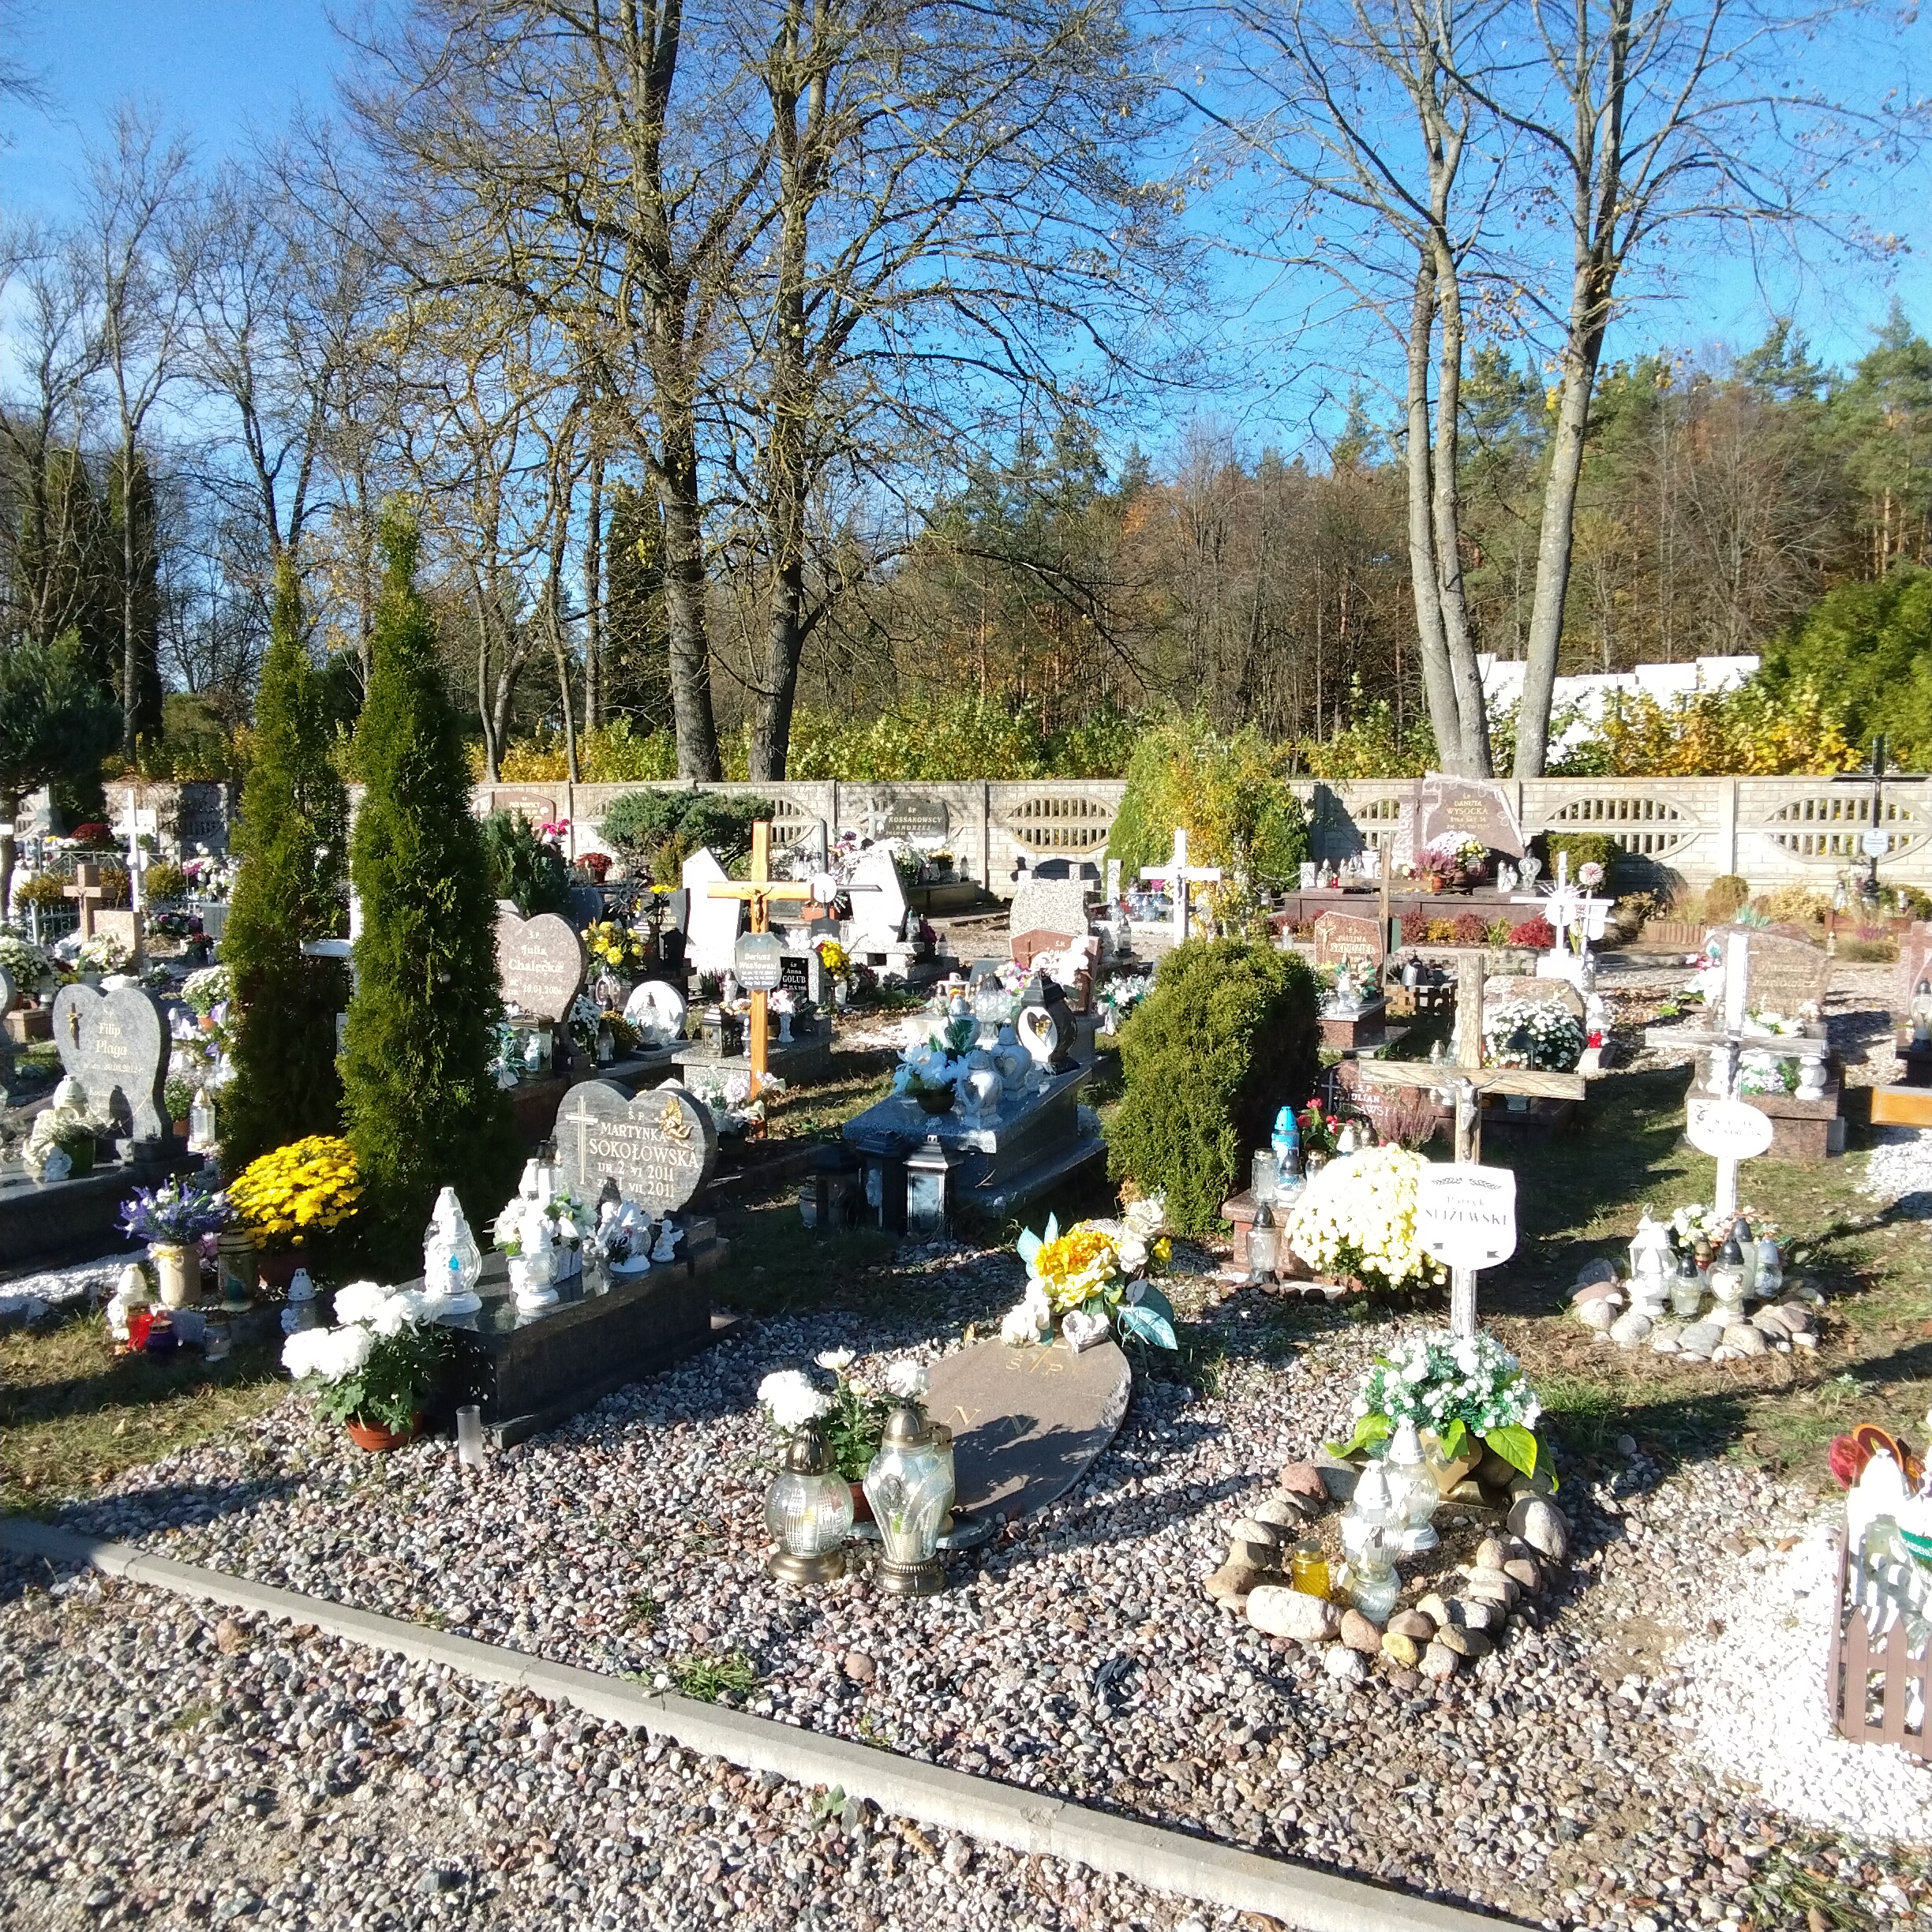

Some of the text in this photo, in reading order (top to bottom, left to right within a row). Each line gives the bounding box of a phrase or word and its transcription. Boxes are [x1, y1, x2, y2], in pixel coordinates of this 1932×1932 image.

[521, 945, 548, 957] Julia
[782, 975, 807, 984] GOLUB
[99, 1022, 121, 1039] Filip
[95, 1040, 128, 1058] Plaga
[601, 1122, 668, 1143] MARTYNKA
[589, 1138, 700, 1169] SOKOŁOWSKA
[617, 1160, 625, 1175] 2
[647, 1164, 674, 1182] 2011
[647, 1181, 675, 1198] 2011
[945, 1405, 982, 1426] N
